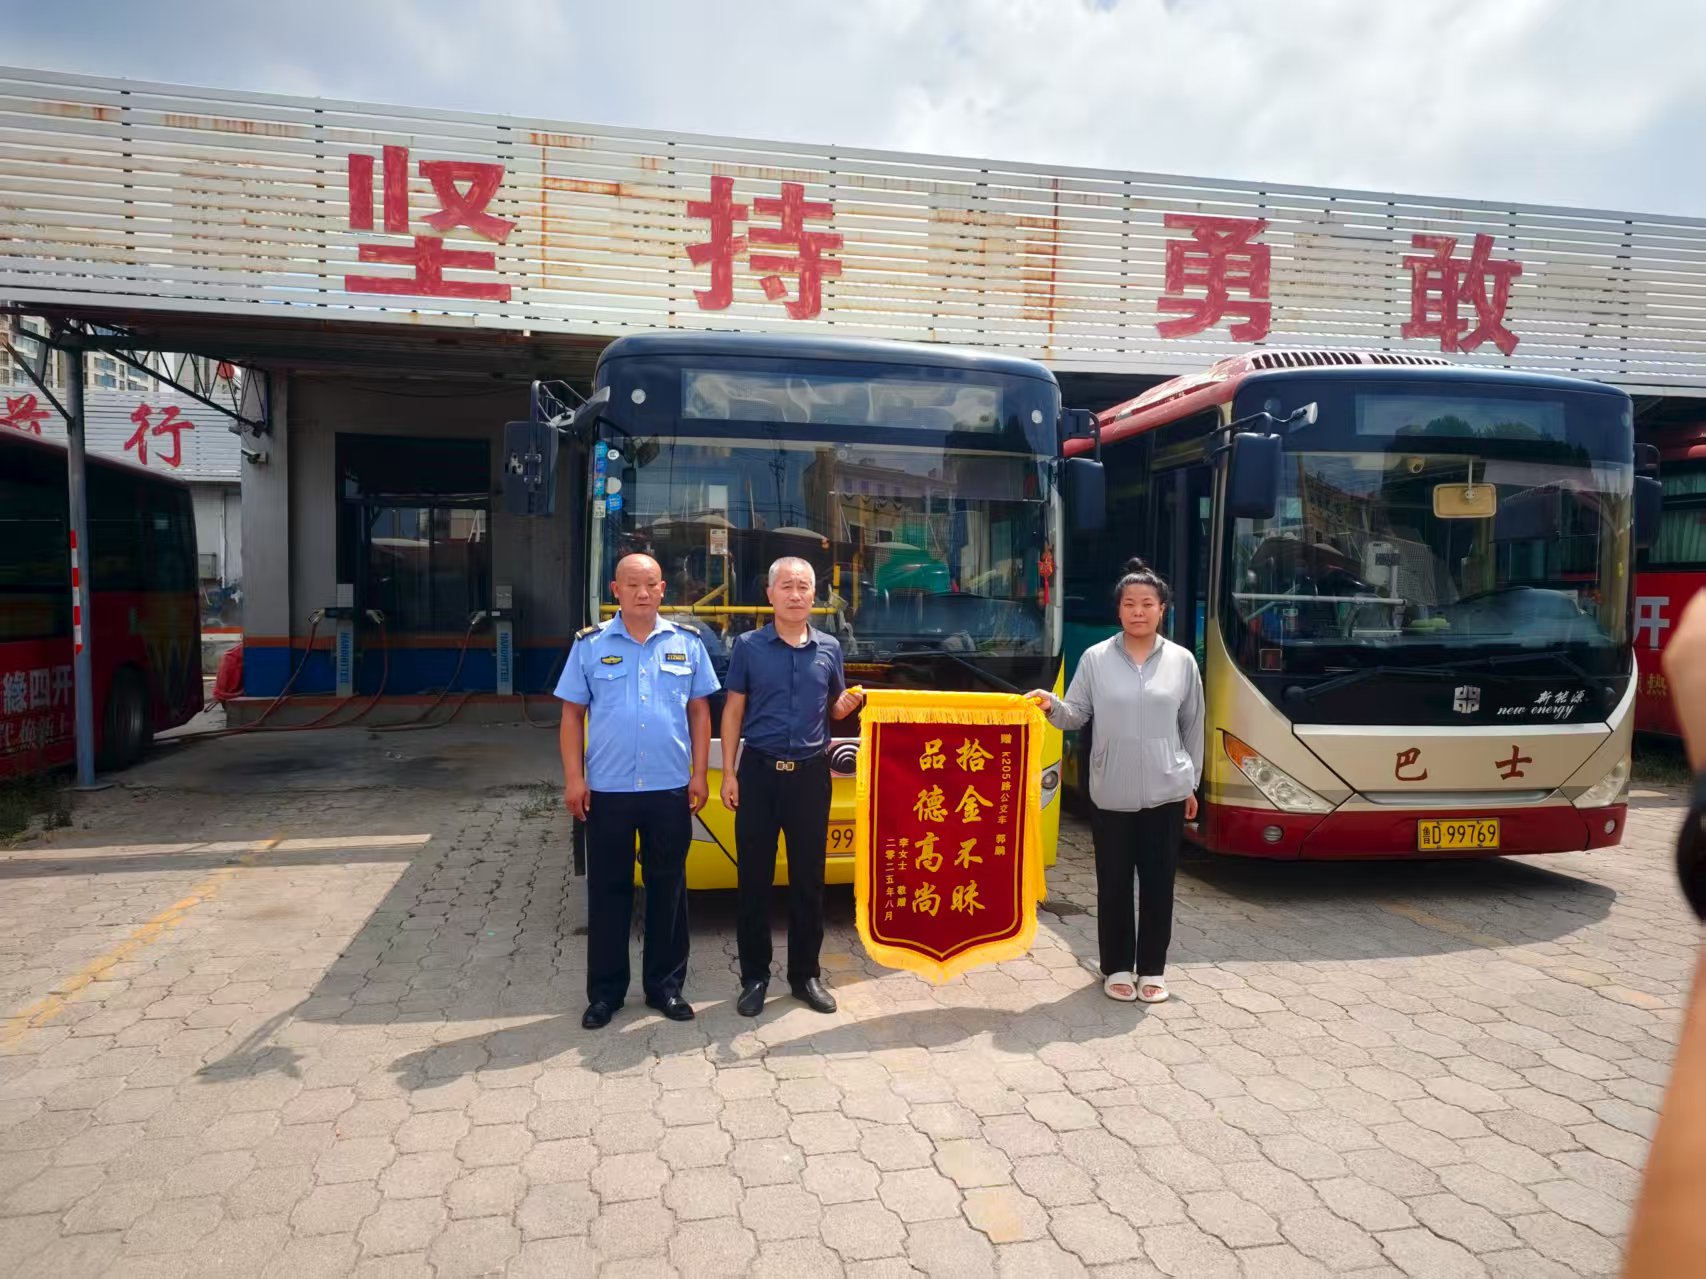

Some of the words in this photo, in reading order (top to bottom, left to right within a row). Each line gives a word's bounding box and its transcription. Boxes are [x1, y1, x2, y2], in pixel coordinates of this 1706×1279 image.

[1497, 706, 1526, 715] new
[1531, 705, 1574, 719] energy
[1534, 690, 1585, 705] 新能源
[1395, 745, 1533, 782] 巴士
[912, 738, 948, 916] 品德高尚
[950, 738, 994, 916] 拾金不昧
[884, 838, 896, 921] 二零二五年八月
